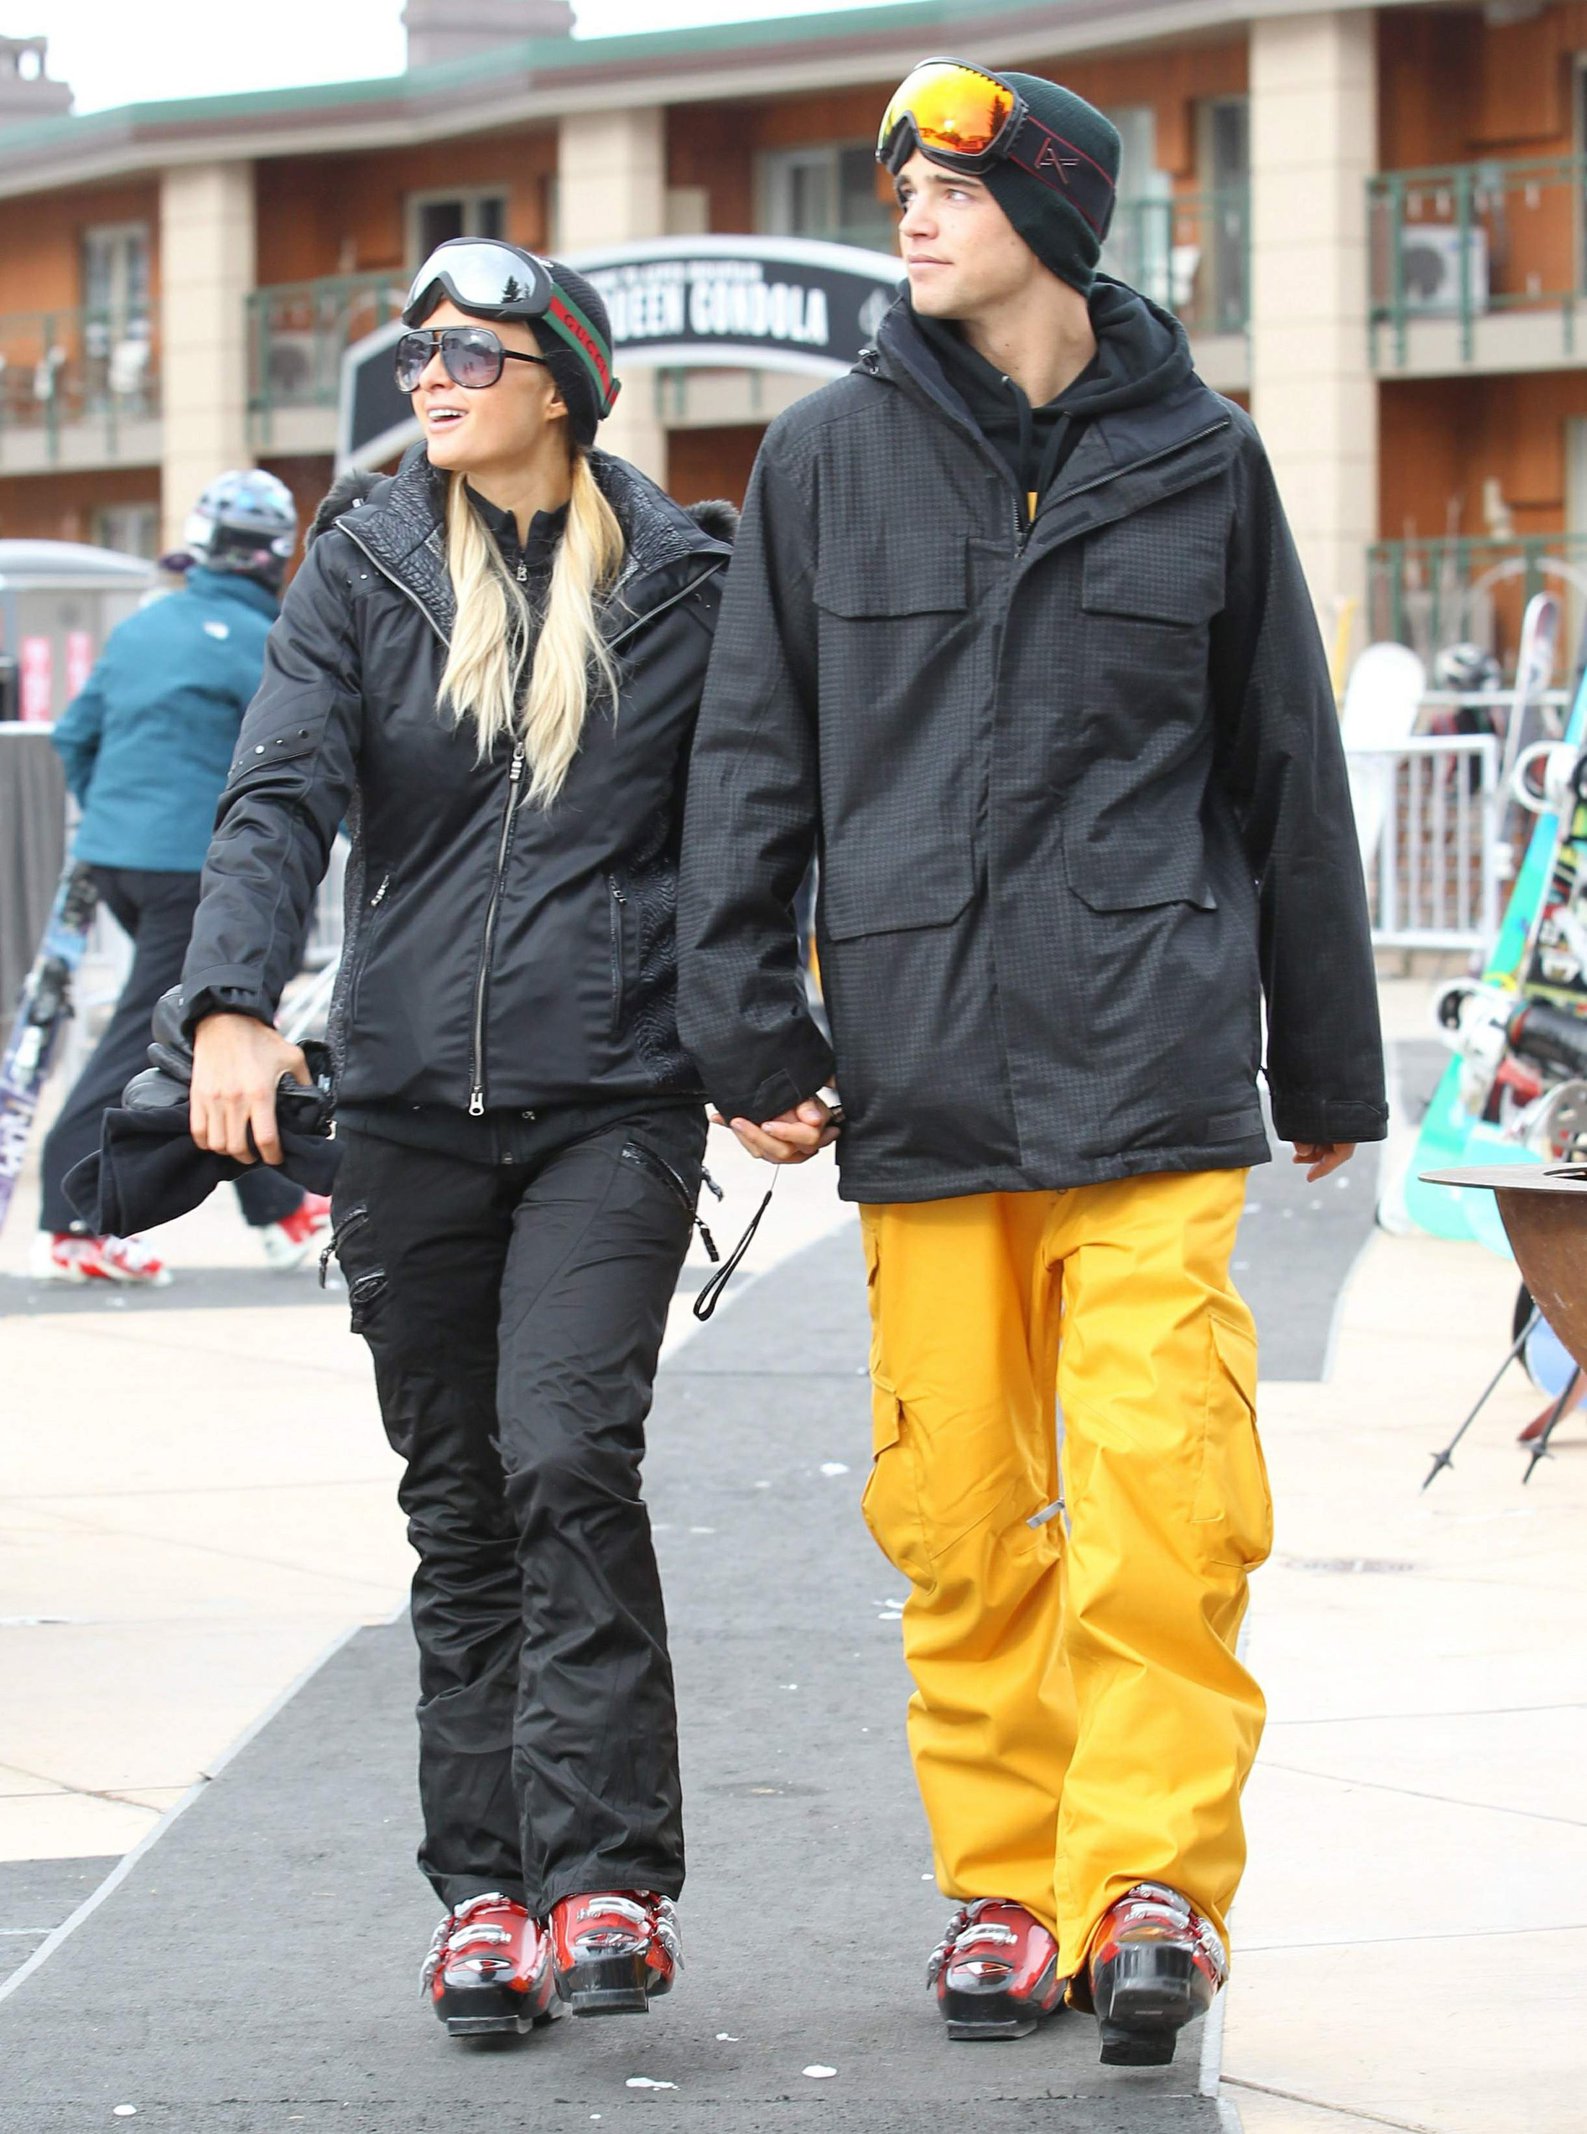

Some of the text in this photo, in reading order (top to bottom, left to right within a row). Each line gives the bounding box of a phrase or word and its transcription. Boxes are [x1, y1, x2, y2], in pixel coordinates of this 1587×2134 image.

[564, 314, 607, 374] GUCCI
[600, 281, 829, 346] UEEN GONDOLA
